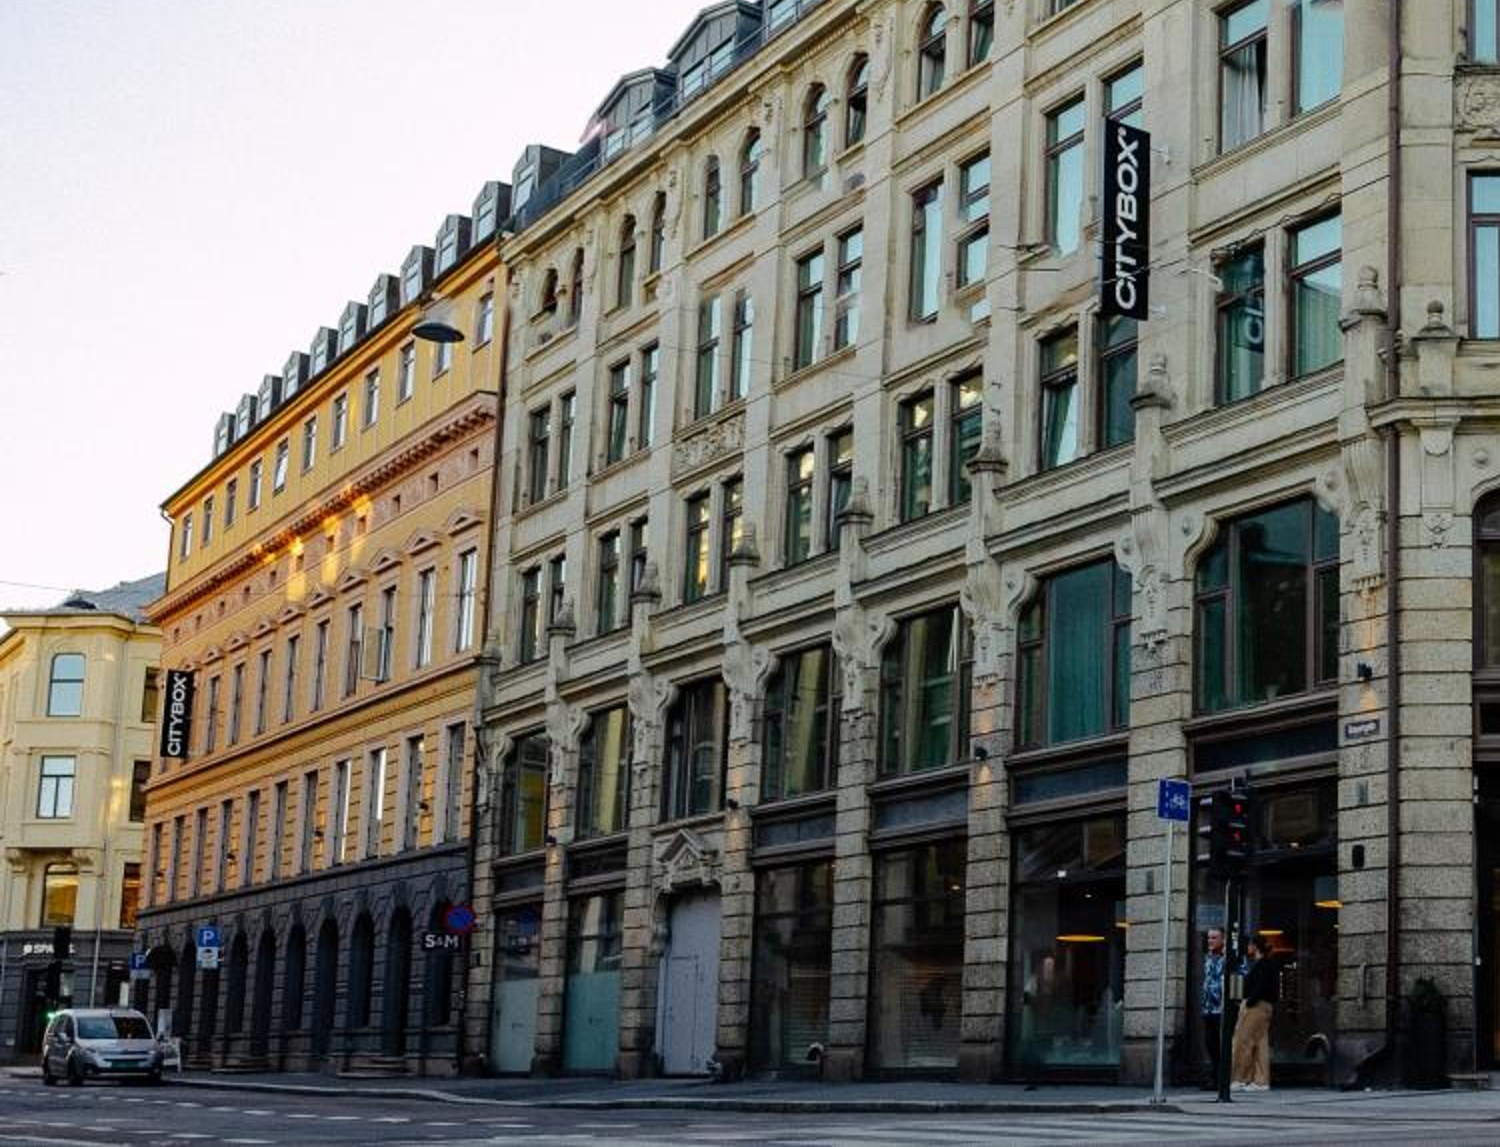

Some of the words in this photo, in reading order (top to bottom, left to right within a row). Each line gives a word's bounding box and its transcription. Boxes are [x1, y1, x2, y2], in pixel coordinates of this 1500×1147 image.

[1115, 133, 1139, 310] CITYBOX
[167, 675, 187, 756] CITYBOX
[203, 930, 215, 945] P
